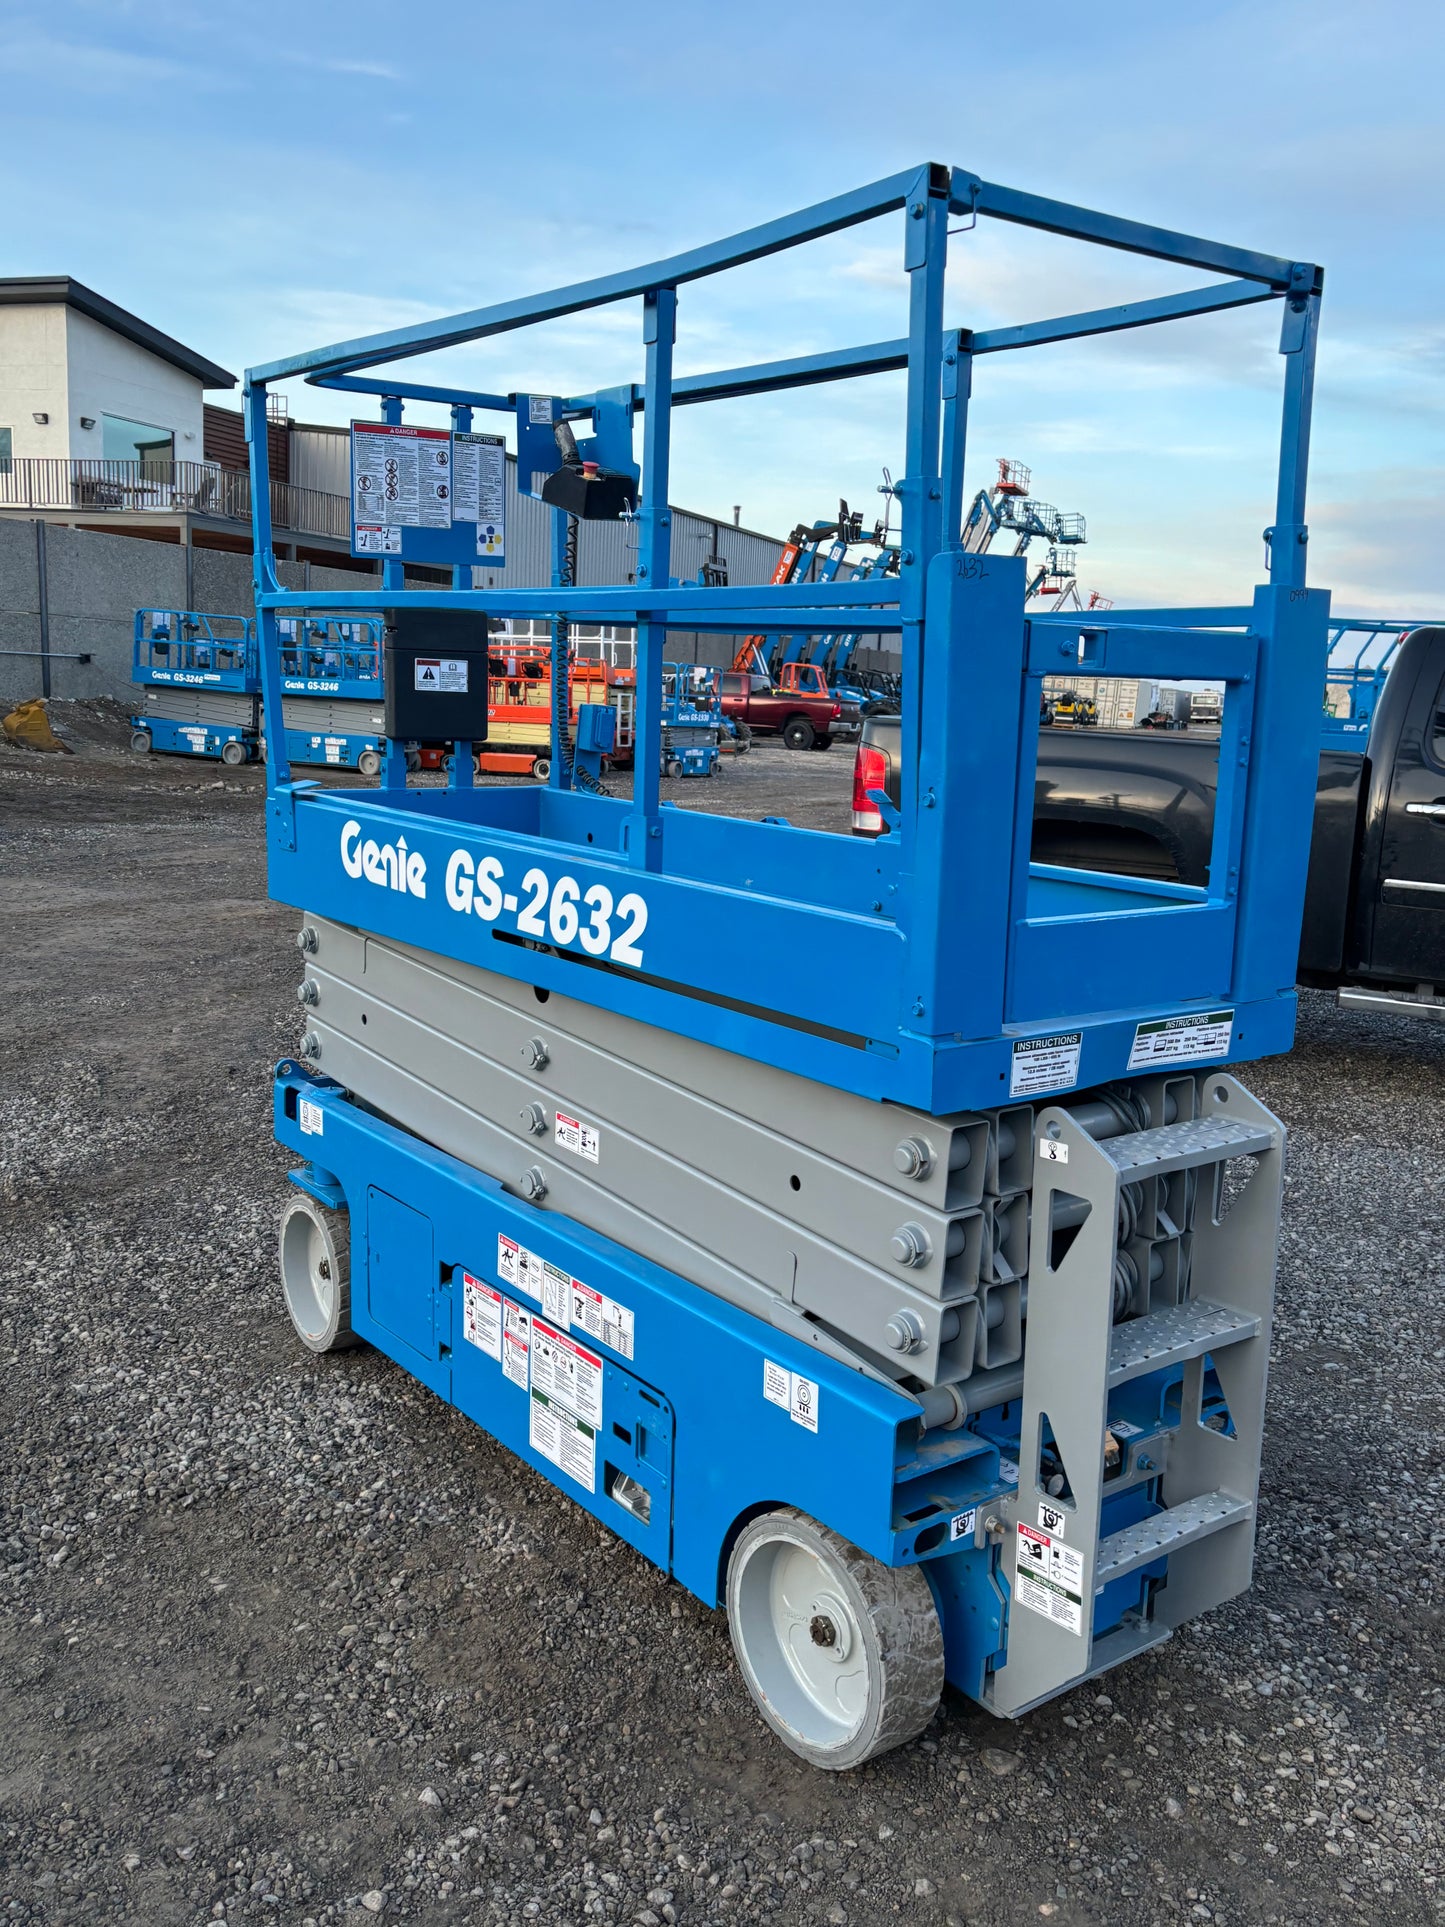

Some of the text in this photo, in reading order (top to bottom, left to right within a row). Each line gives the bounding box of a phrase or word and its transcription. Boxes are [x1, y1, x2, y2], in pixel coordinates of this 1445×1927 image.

[394, 428, 418, 436] DANGER
[461, 435, 498, 444] INSTRUCTIONS
[956, 557, 990, 580] 2632
[152, 671, 171, 680] Genie
[173, 673, 204, 684] GS-3246
[285, 680, 339, 691] Genie GS-3246
[341, 820, 648, 968] Genie GS-2632
[1165, 1016, 1209, 1029] INSTRUCTIONS
[1017, 1034, 1078, 1052] INSTRUCTIONS
[476, 1281, 494, 1297] DANGER
[580, 1283, 597, 1299] DANGER
[560, 1336, 577, 1352] DANGER
[1027, 1529, 1047, 1544] DANGER
[1033, 1574, 1067, 1597] INSTRUCTIONS
